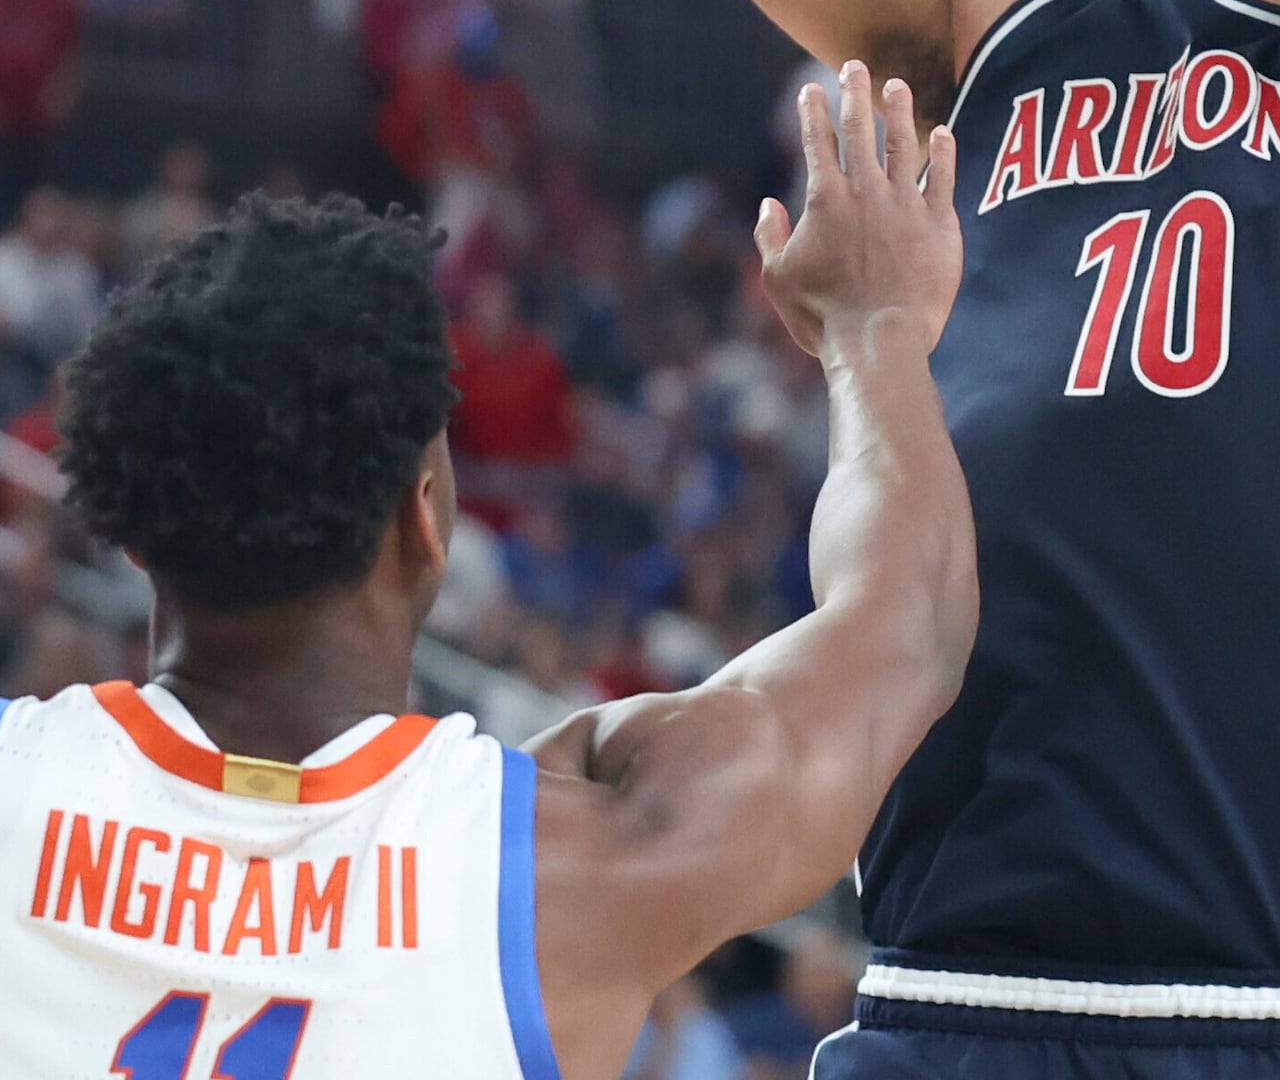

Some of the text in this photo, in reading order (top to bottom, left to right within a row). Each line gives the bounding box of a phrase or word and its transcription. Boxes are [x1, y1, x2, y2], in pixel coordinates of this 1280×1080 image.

[1063, 189, 1235, 399] 10
[30, 808, 418, 958] INGRAM II
